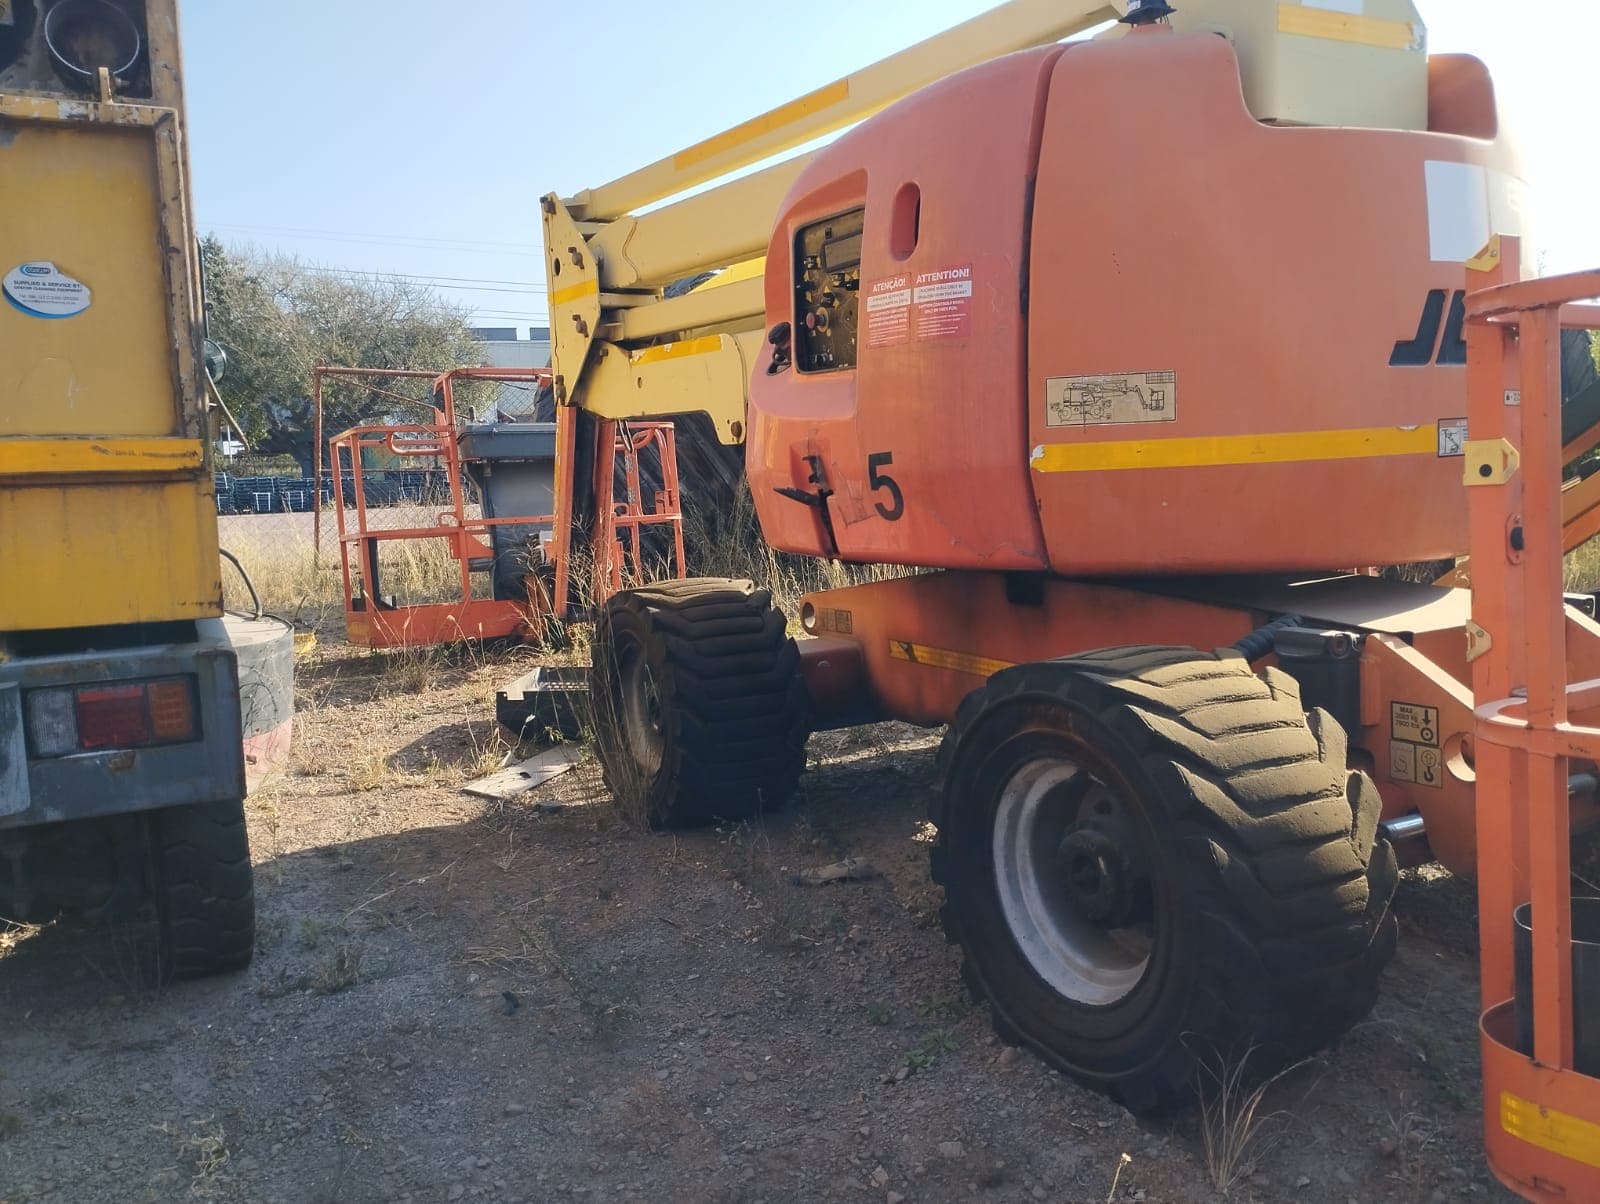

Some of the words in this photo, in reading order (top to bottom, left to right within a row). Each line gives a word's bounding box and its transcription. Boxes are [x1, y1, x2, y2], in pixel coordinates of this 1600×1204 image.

[872, 277, 906, 293] ATENÇÃO!
[916, 268, 970, 284] ATTENTION!
[1389, 289, 1467, 366] JL
[868, 451, 904, 521] 5
